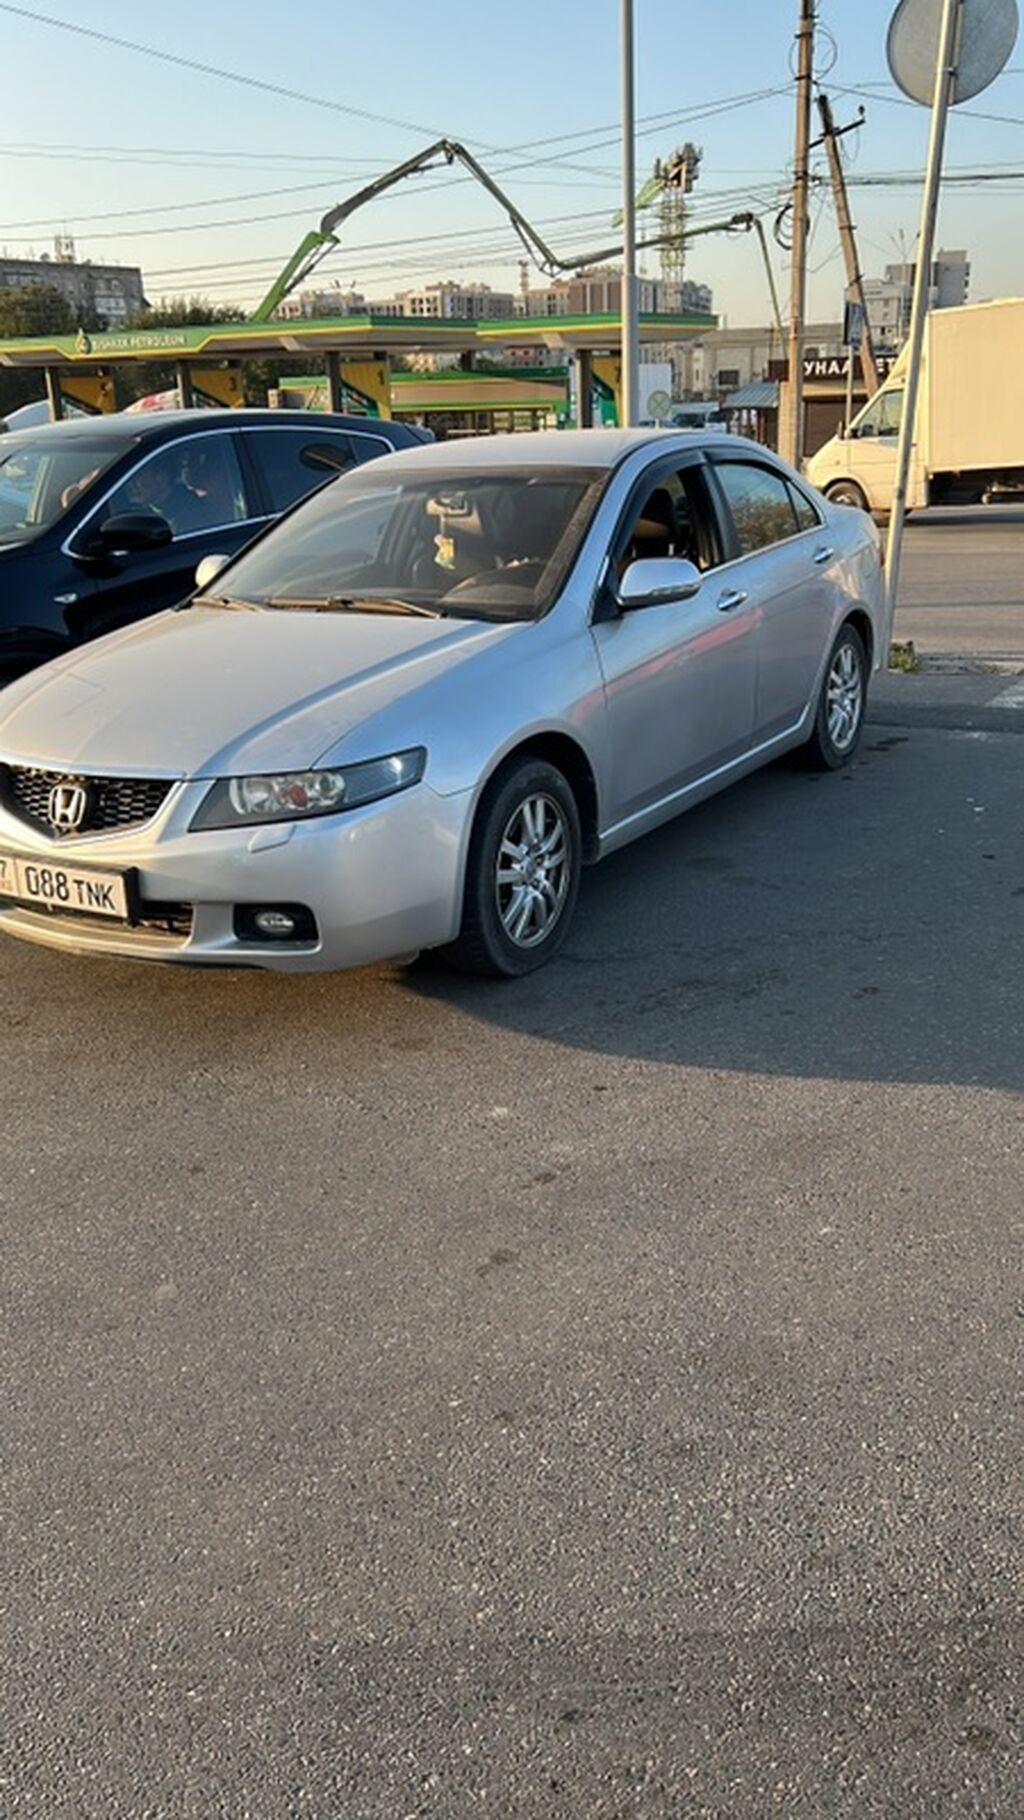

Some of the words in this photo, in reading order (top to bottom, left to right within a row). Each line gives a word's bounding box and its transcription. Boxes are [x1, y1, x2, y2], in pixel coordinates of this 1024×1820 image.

[229, 377, 238, 391] 3
[25, 866, 69, 901] 088
[73, 879, 115, 910] TNK
